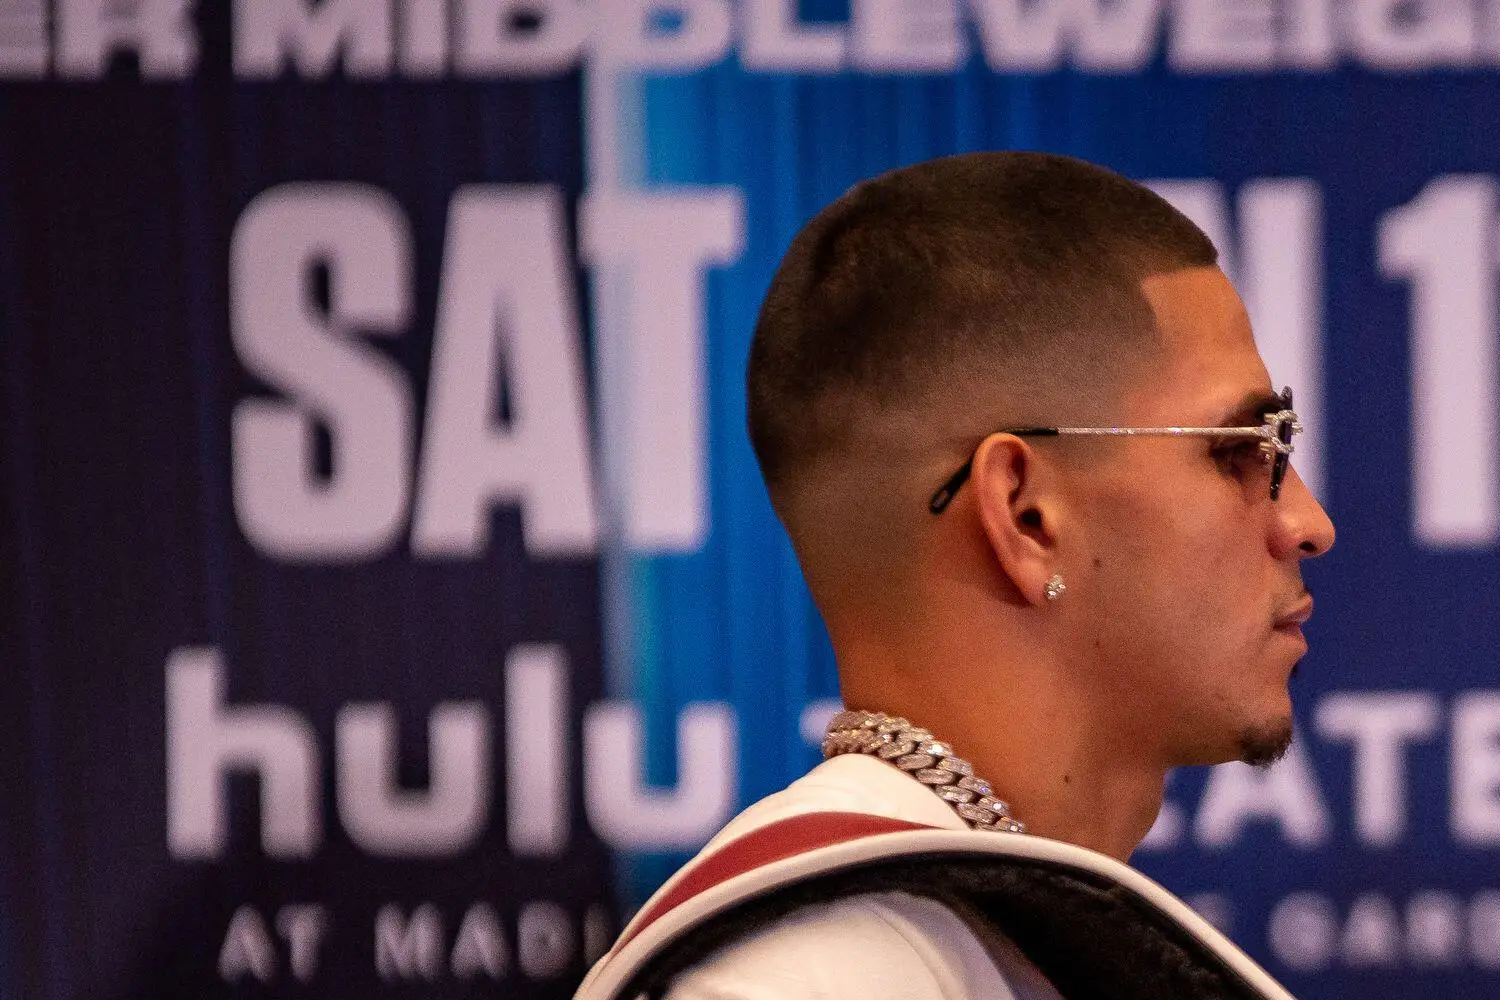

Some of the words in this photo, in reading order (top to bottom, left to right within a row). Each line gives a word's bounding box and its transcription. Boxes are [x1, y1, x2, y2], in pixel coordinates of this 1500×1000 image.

[230, 182, 744, 560] SAT
[165, 645, 738, 858] hulu
[218, 903, 326, 981] AT
[374, 901, 616, 980] MADI
